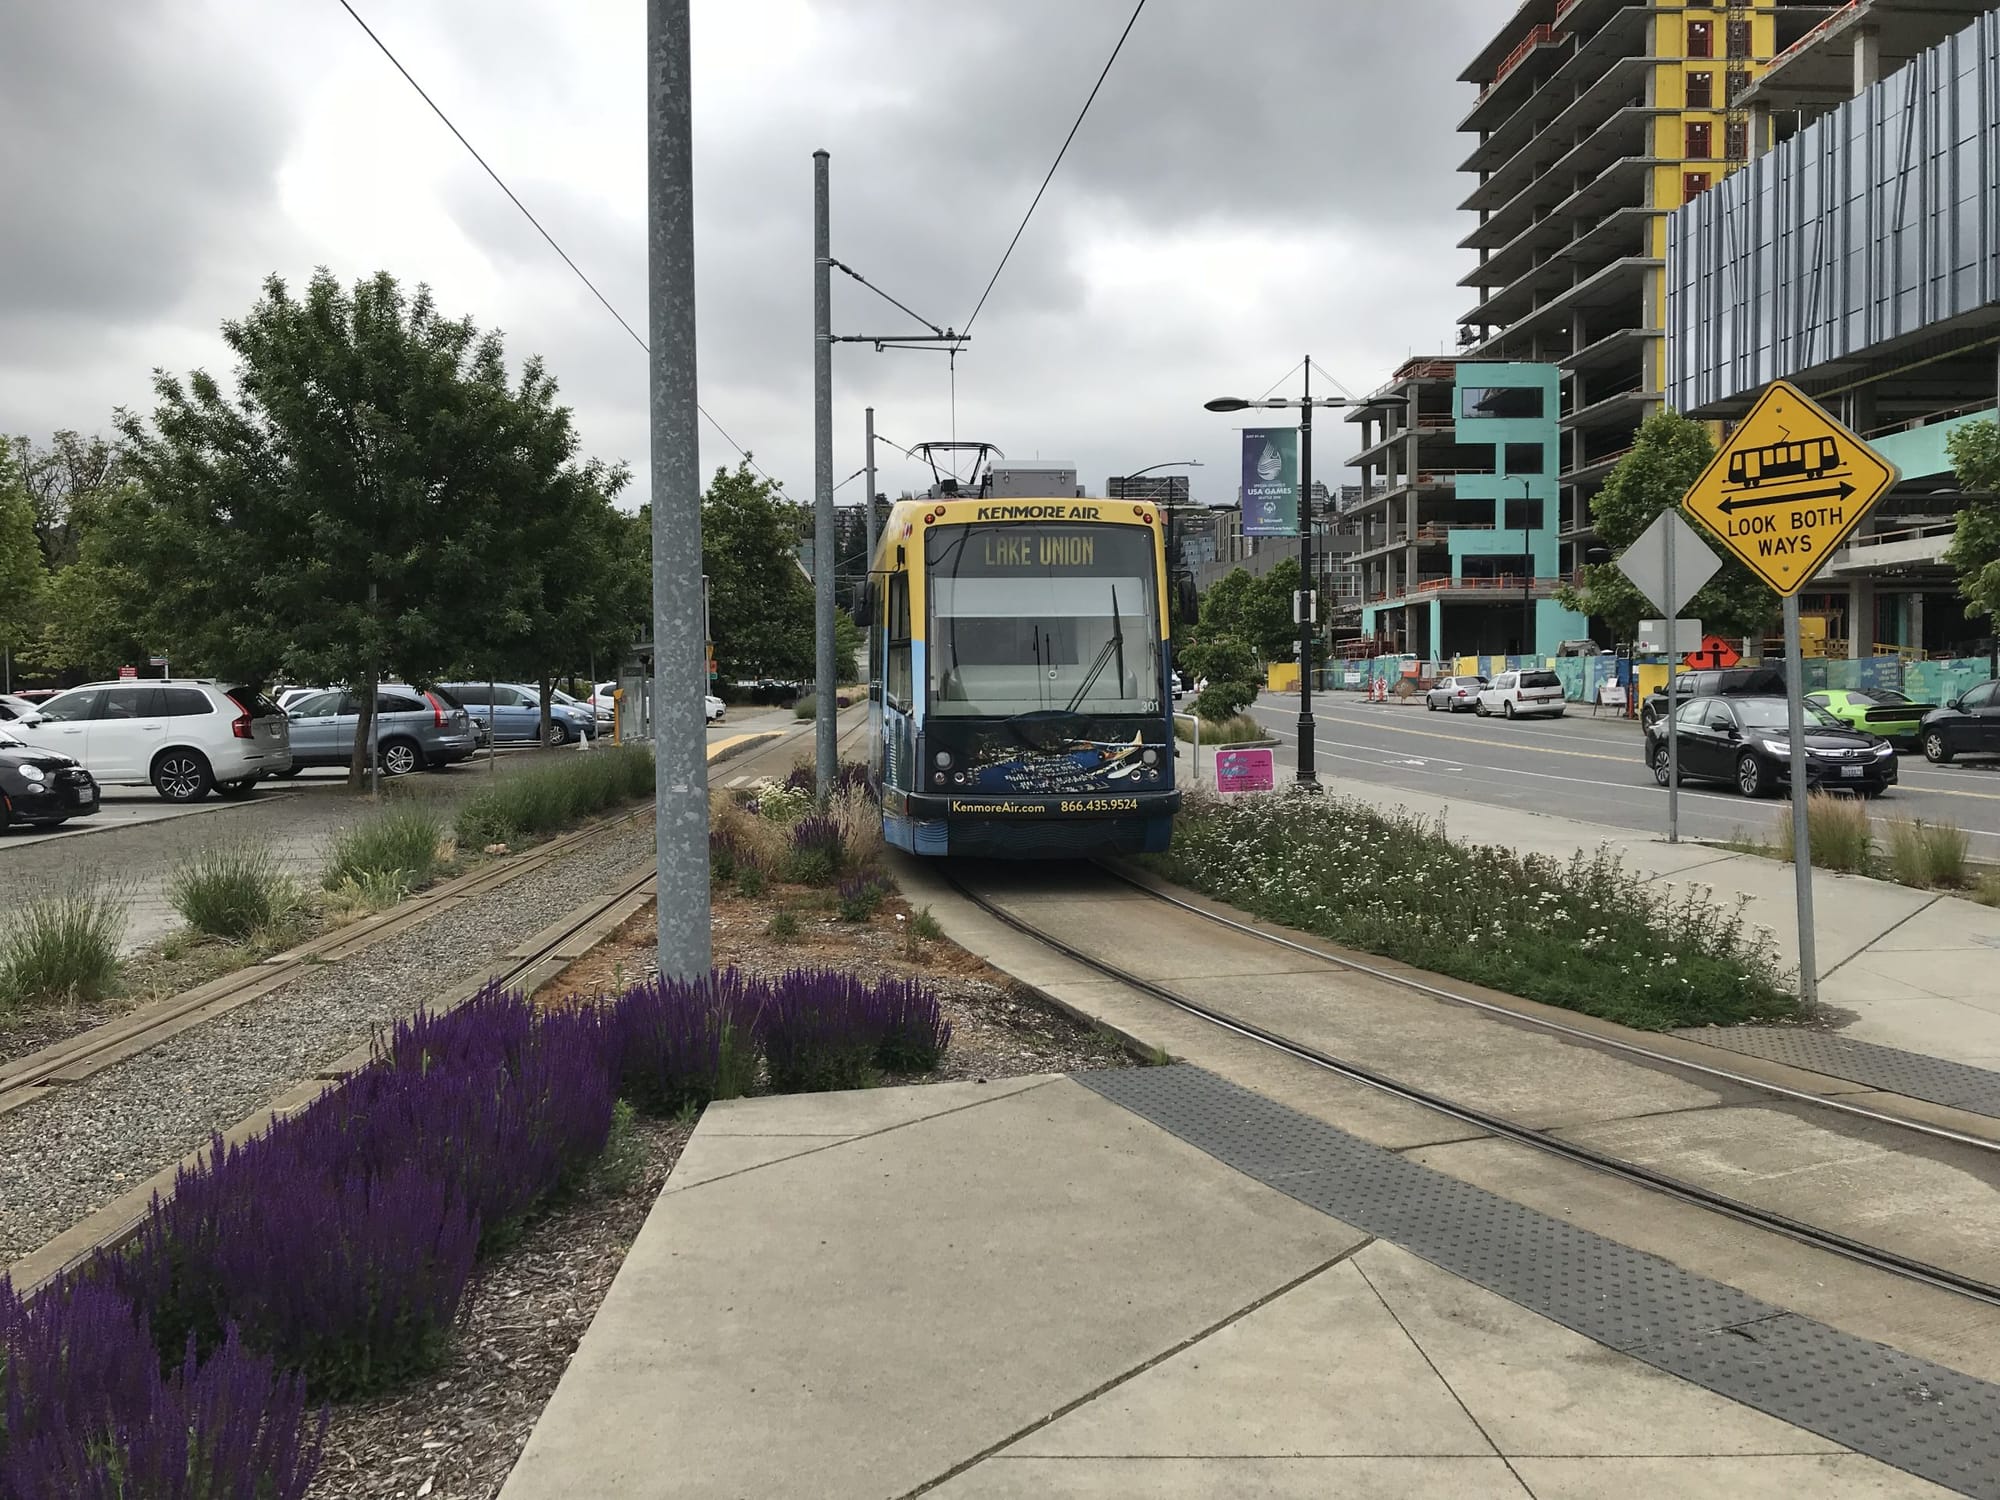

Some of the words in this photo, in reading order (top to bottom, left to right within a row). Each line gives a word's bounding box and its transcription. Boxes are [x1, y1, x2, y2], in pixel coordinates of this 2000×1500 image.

[1247, 488, 1264, 496] USA
[1264, 487, 1292, 495] GAMES
[977, 505, 1066, 520] KENMORE
[1068, 506, 1102, 520] AIR
[1727, 514, 1777, 537] LOOK
[1790, 506, 1843, 530] BOTH
[985, 536, 1032, 566] LAKE
[1040, 536, 1094, 566] UNION
[1758, 534, 1812, 557] WAYS
[1141, 700, 1160, 712] 301
[952, 800, 1046, 813] KenmoreAir.com
[1060, 799, 1138, 812] 866.435.9524
